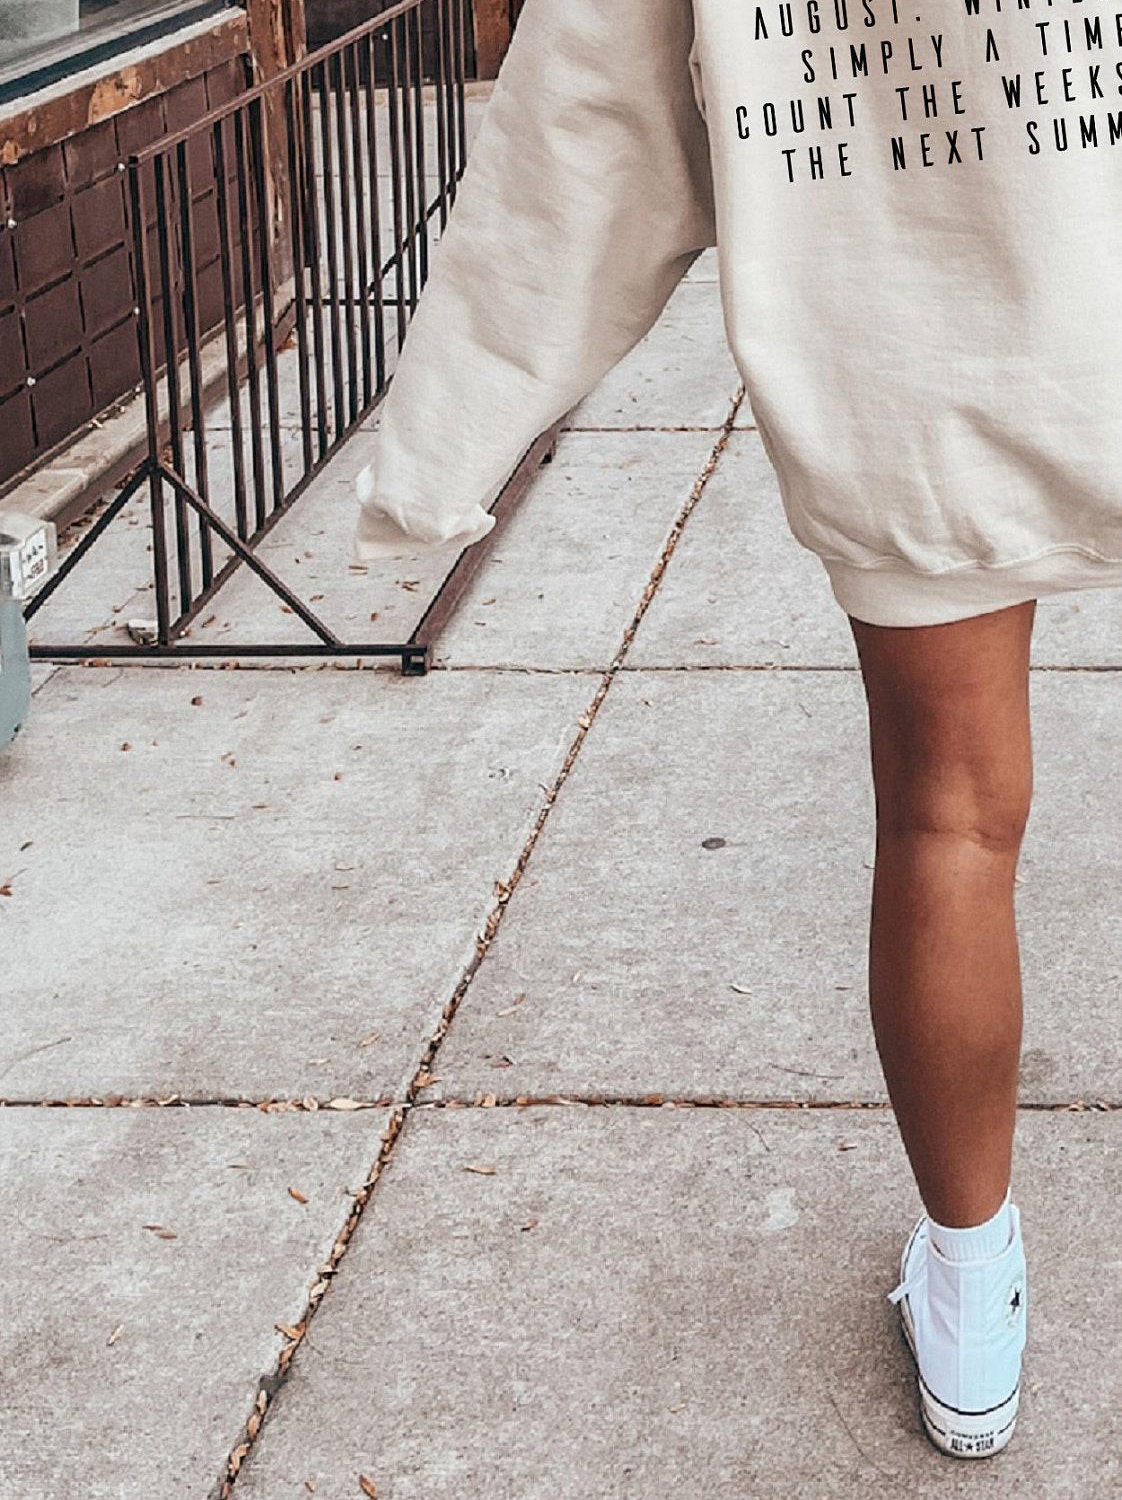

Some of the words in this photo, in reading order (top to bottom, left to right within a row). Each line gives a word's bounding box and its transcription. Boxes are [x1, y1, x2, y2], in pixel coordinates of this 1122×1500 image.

[801, 34, 944, 84] SIMPLY
[985, 28, 1000, 63] A
[735, 92, 858, 140] COUNT
[895, 80, 966, 121] THE
[781, 142, 852, 183] THE
[890, 126, 986, 171] NEXT
